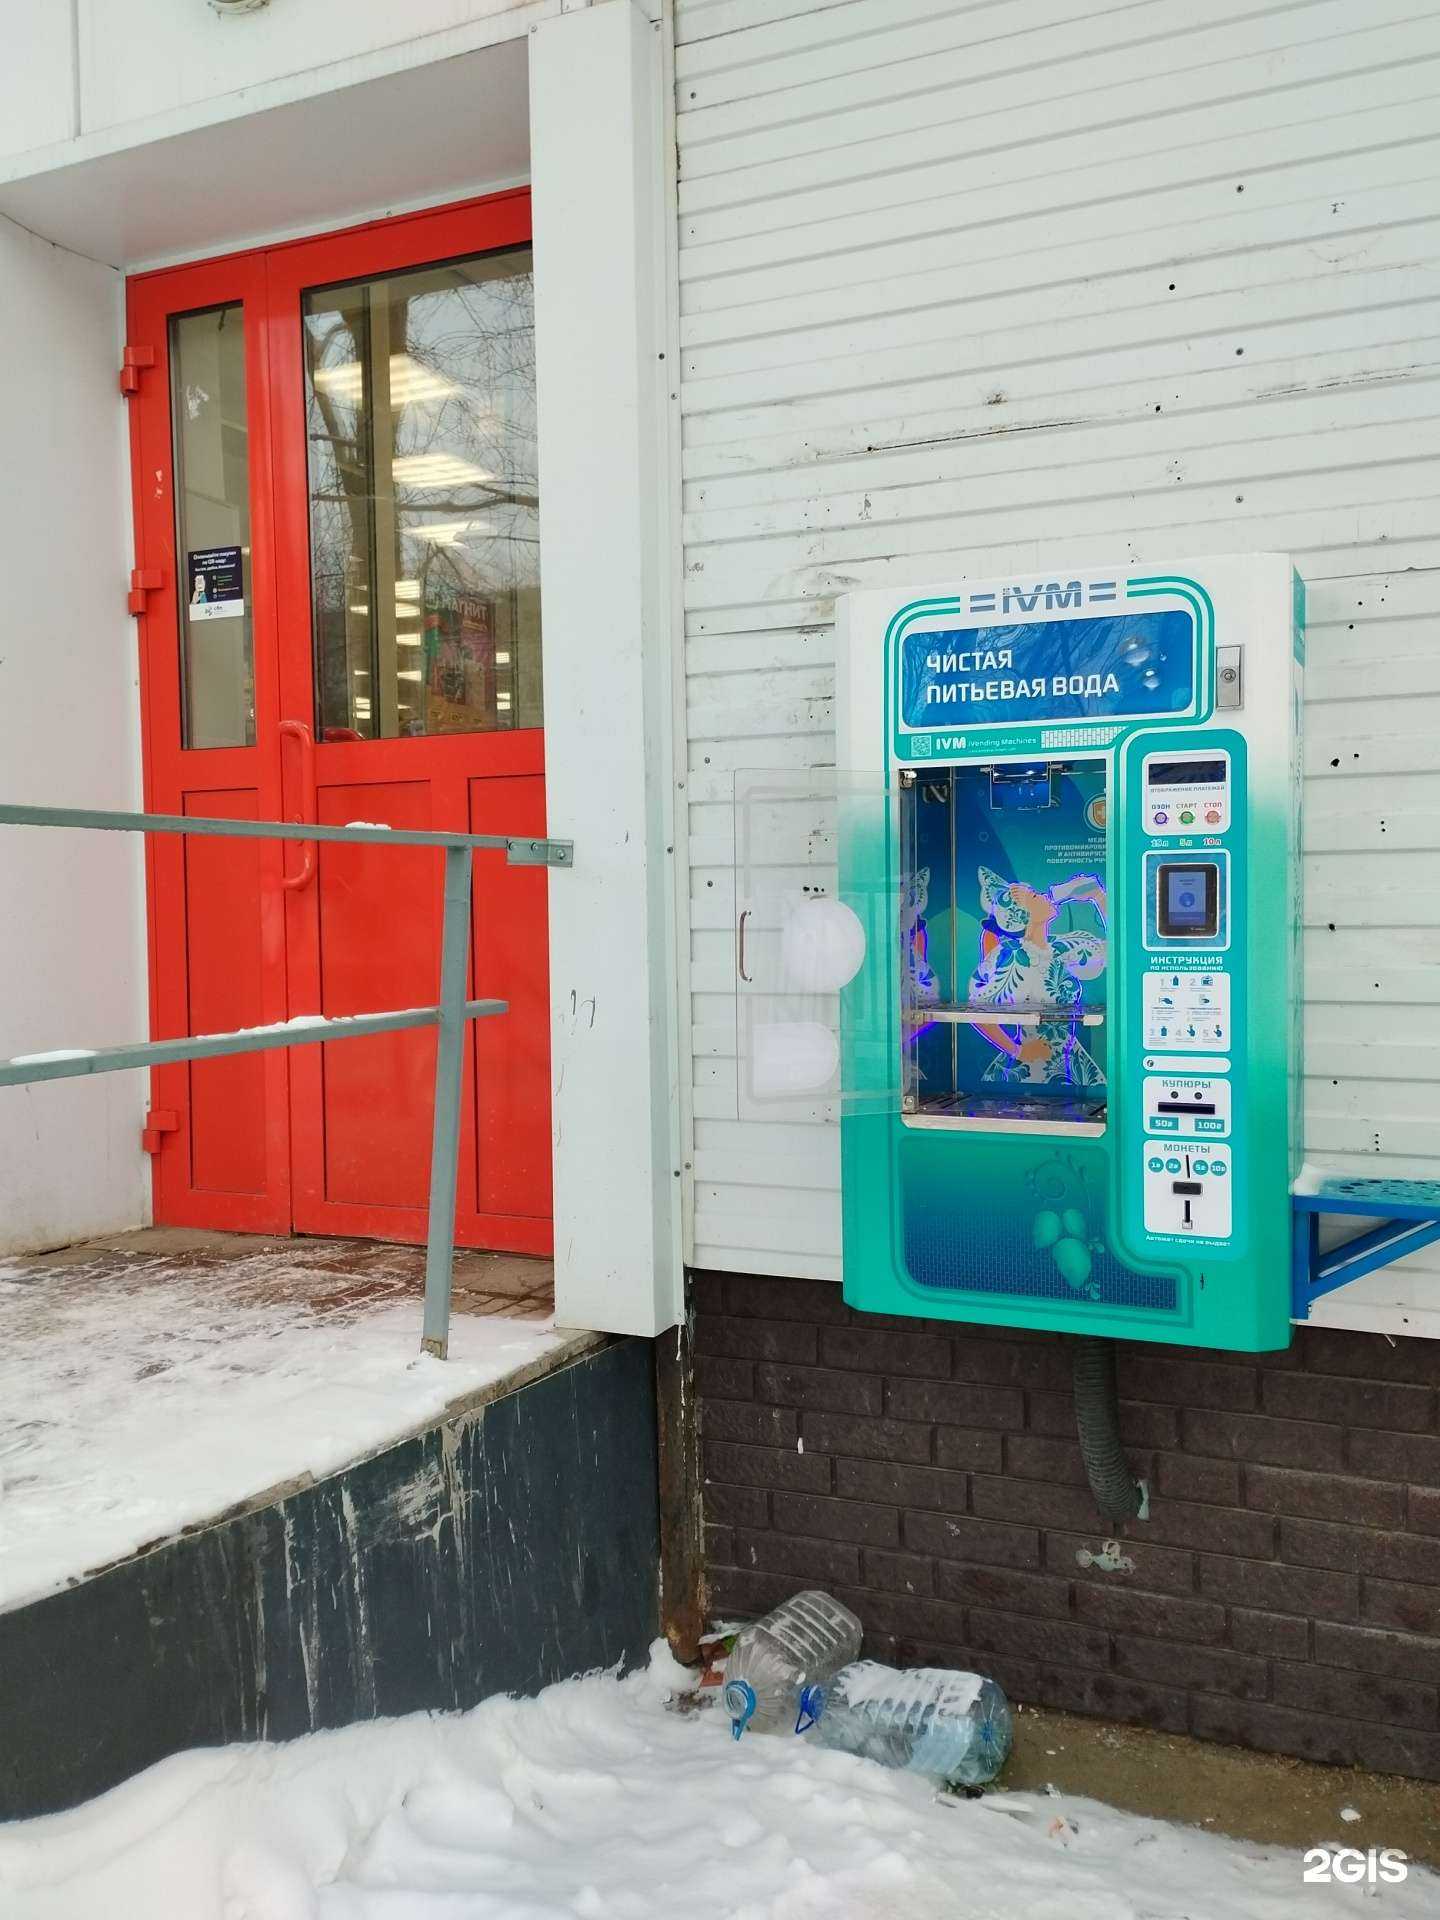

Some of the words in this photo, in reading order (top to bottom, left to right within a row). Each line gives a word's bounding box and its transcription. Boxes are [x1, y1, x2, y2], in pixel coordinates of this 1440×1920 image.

[926, 649, 1013, 674] ЧИСТАЯ
[926, 678, 1046, 704] ПИТЬЕВАЯ
[1052, 673, 1120, 698] ВОДА
[1176, 802, 1198, 810] СТАРТ
[1203, 801, 1222, 809] СТОП
[1150, 956, 1223, 966] ИНСТРУКЦИЯ
[1162, 1079, 1212, 1089] КУПЮРЫ
[1163, 1143, 1211, 1154] МОНЕТЫ
